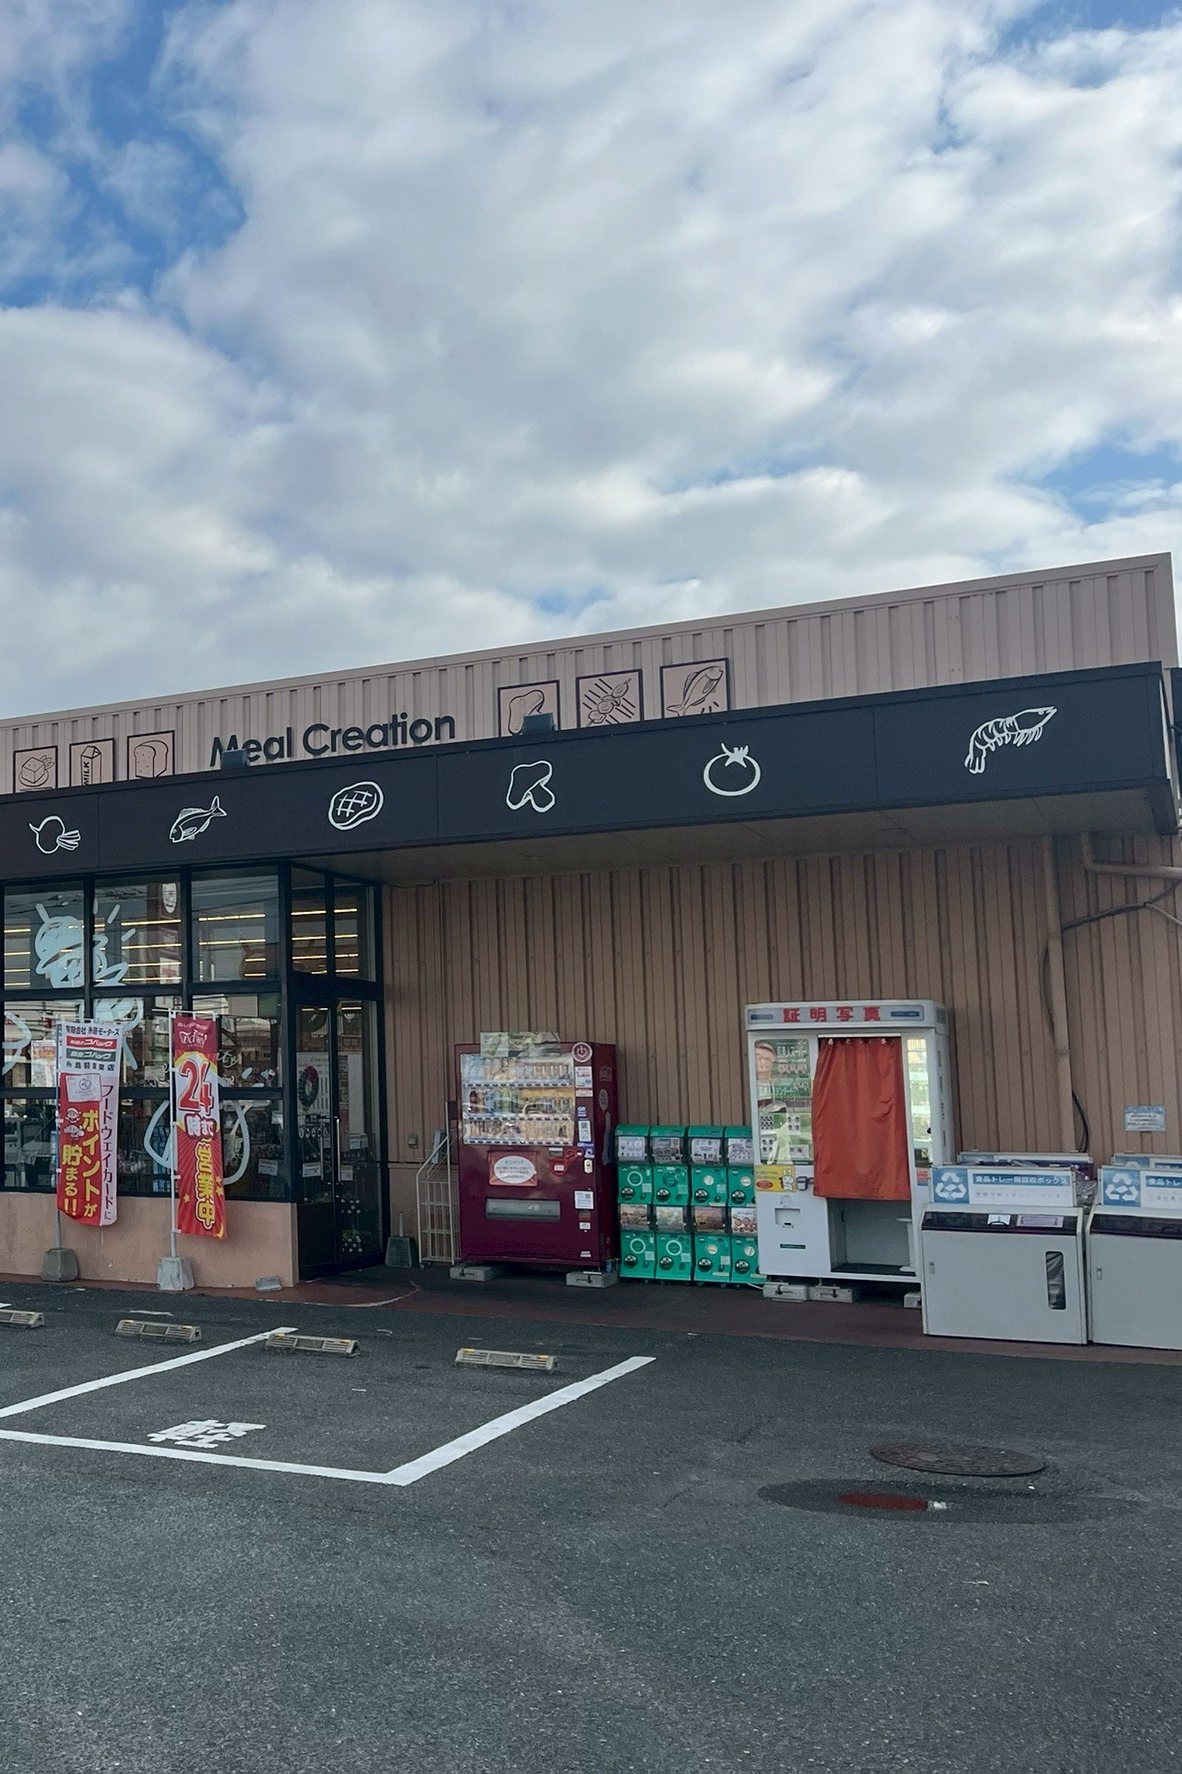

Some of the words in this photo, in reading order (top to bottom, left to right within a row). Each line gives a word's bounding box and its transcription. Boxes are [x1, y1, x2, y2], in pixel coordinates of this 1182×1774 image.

[209, 727, 292, 767] Meal
[303, 712, 455, 756] Creation
[783, 1005, 881, 1023] 証明写真
[179, 1058, 214, 1116] 24
[196, 1142, 216, 1229] 営業中
[147, 1419, 267, 1449] 軽
